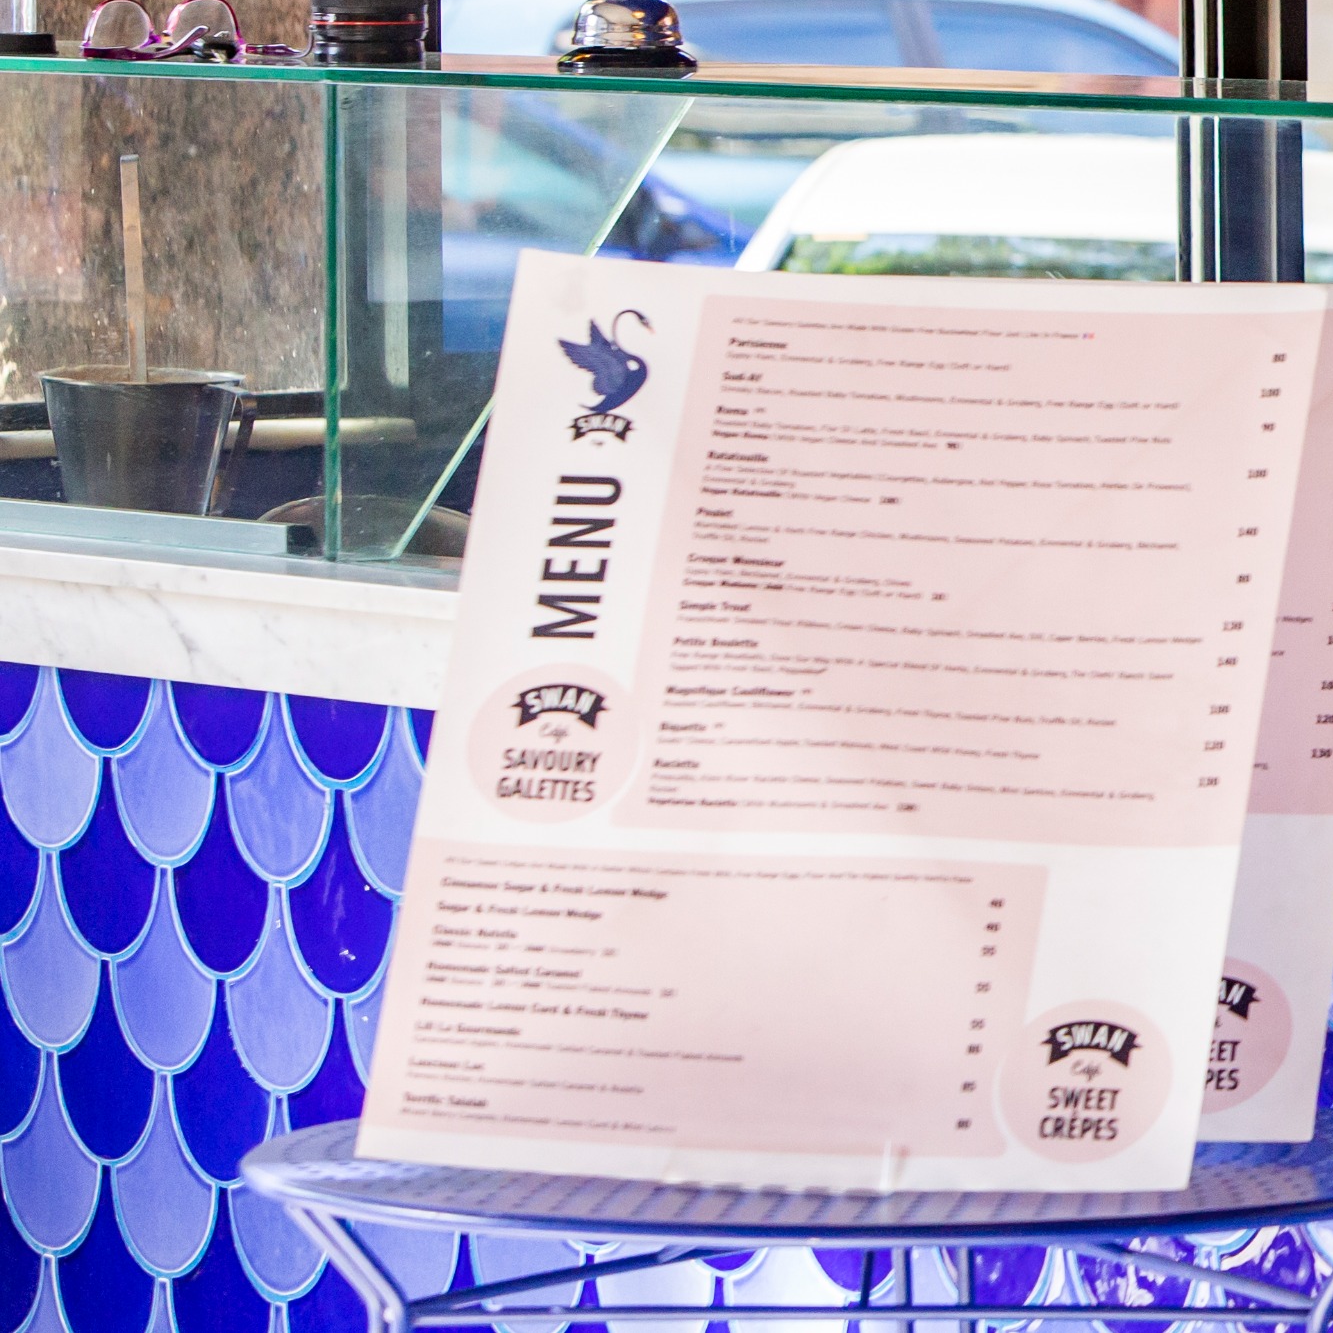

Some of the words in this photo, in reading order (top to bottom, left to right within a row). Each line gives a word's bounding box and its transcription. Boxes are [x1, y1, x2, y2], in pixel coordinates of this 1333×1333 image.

[577, 413, 627, 434] SWAN
[529, 475, 624, 640] MENU
[525, 688, 598, 714] SWAN
[501, 748, 602, 773] SAVOURY
[1311, 749, 1333, 759] 130
[496, 777, 597, 802] GALETTES
[1056, 1024, 1128, 1052] SWAN
[1208, 1040, 1241, 1062] EET
[1205, 1069, 1239, 1090] PES
[1049, 1087, 1121, 1110] SWEET
